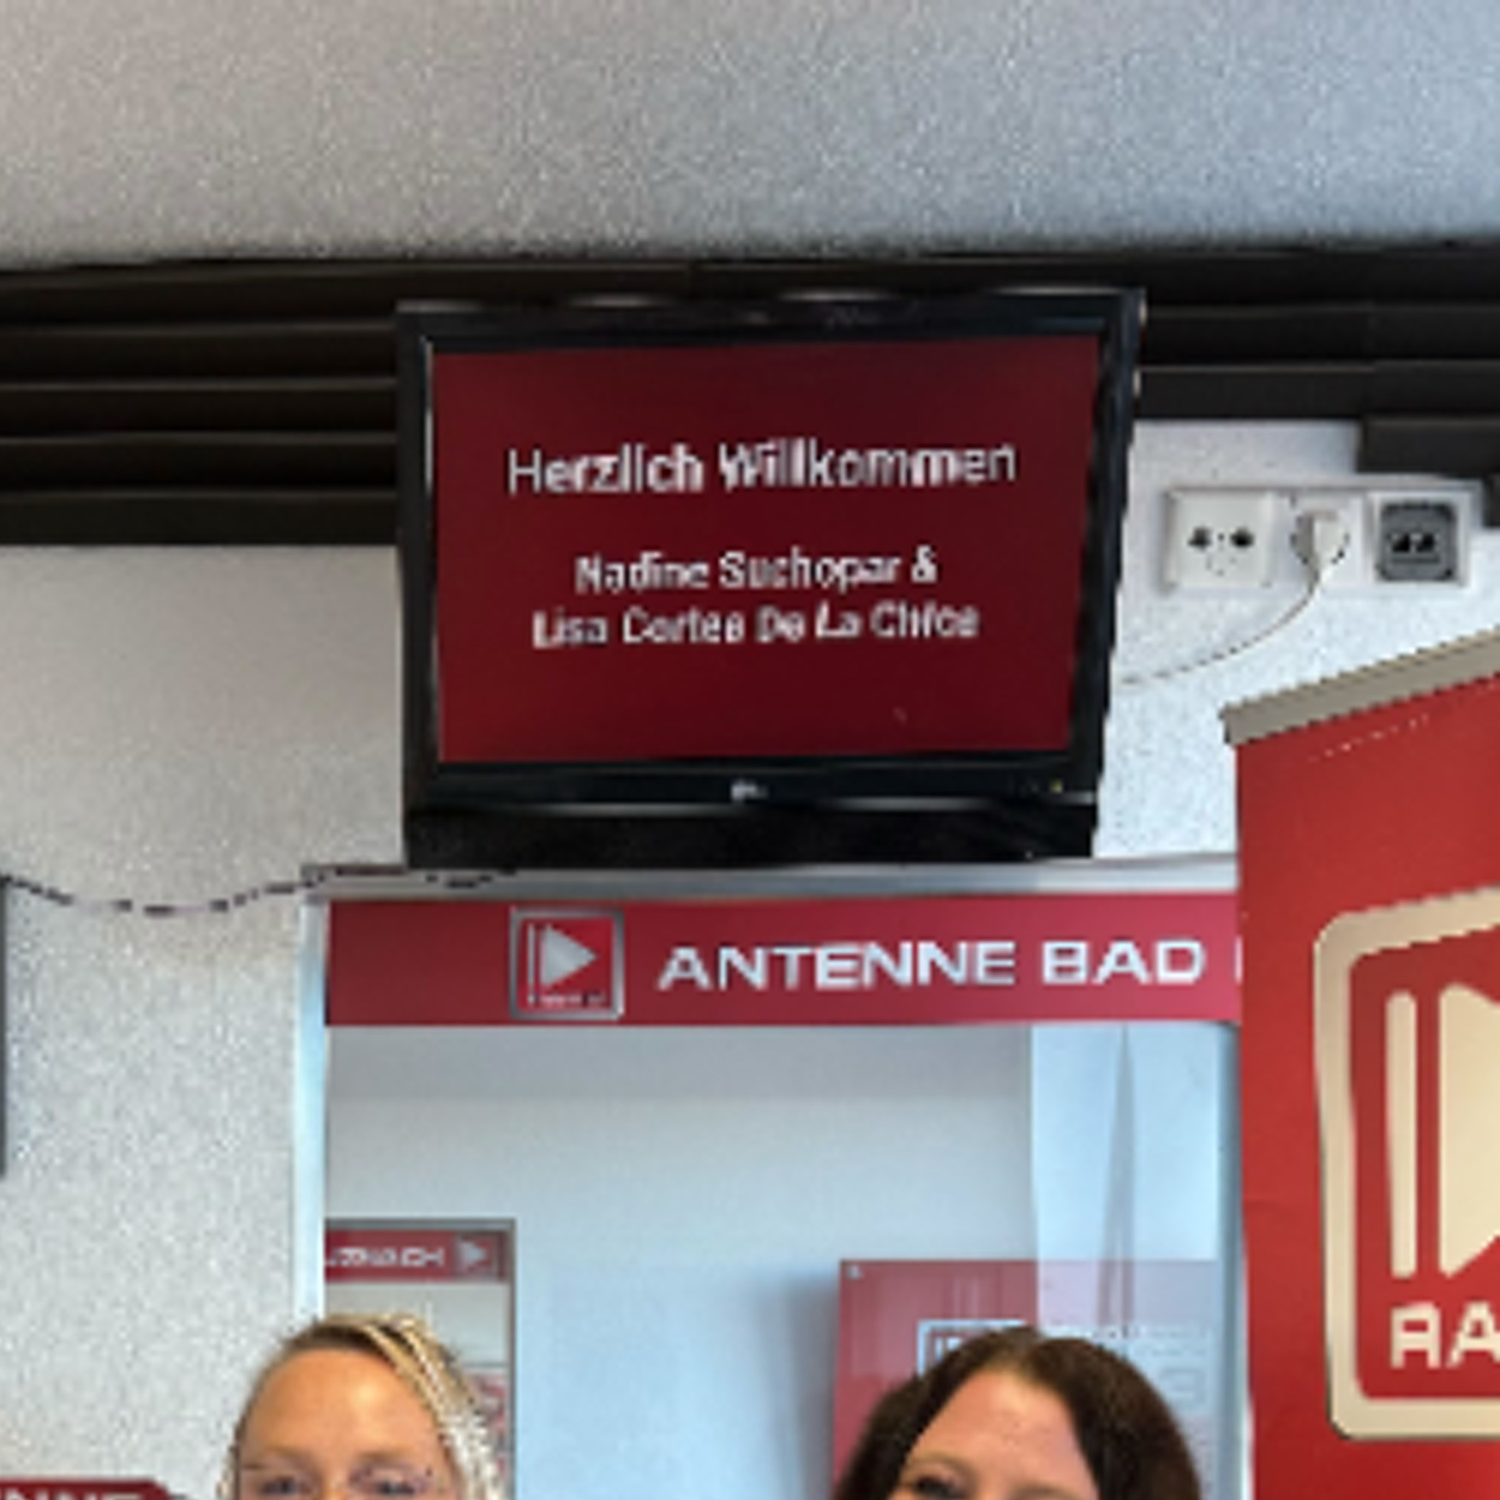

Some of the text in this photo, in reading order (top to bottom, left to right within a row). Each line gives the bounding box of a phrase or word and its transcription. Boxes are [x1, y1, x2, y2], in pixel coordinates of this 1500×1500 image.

[507, 438, 1017, 496] Herzlich Willkommen
[574, 544, 938, 594] Nadine Suchopar &
[532, 609, 608, 650] Lisa
[656, 938, 1207, 991] ANTENNE BAD
